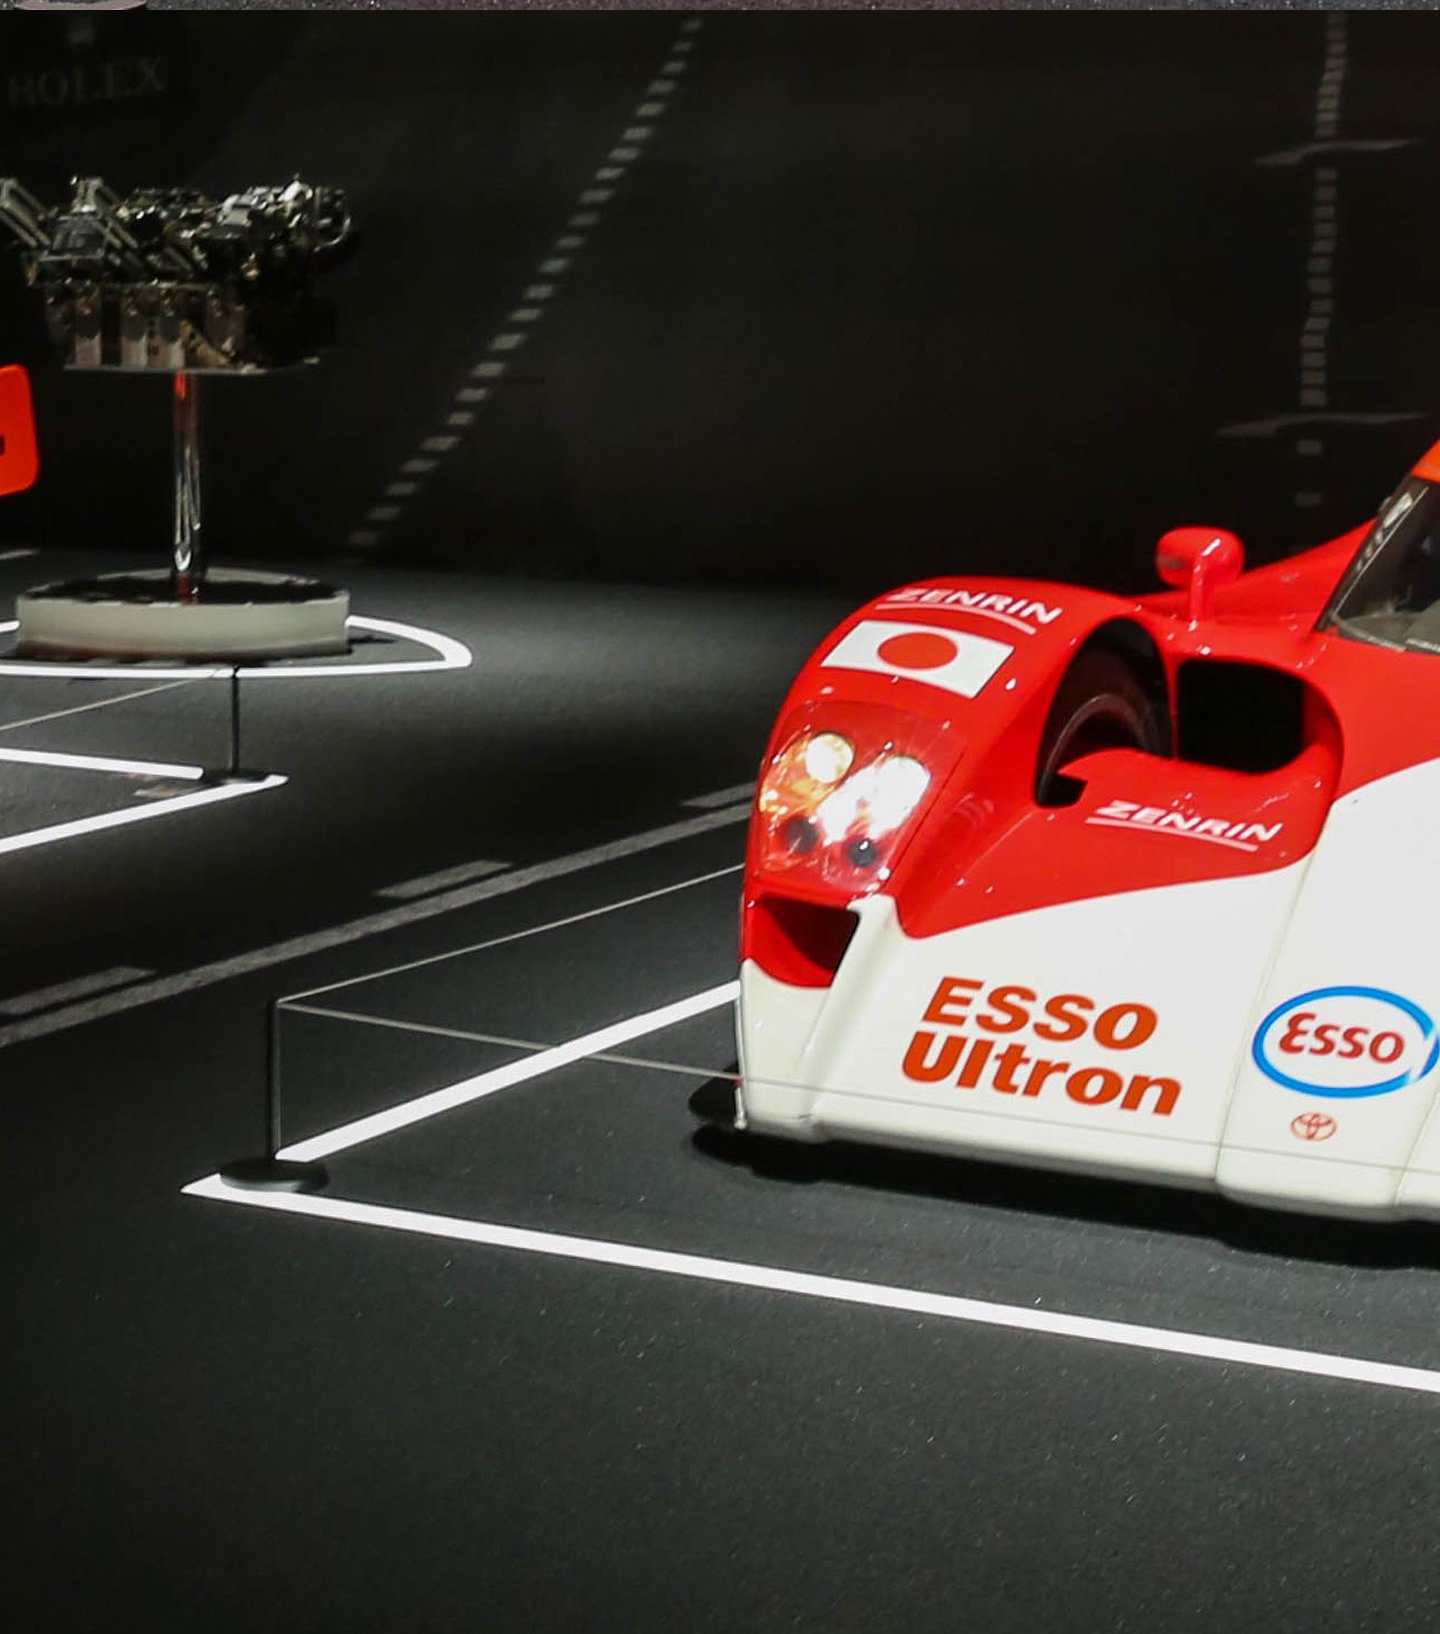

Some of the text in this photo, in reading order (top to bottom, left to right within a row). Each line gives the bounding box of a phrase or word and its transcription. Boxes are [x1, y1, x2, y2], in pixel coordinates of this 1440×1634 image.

[7, 54, 168, 109] ROLEX
[891, 588, 1063, 626] ZENRIN
[1096, 799, 1284, 843] ZENRIN
[920, 974, 1160, 1053] ESSO
[1277, 1010, 1406, 1065] Esso
[900, 1029, 1184, 1118] Ultron
